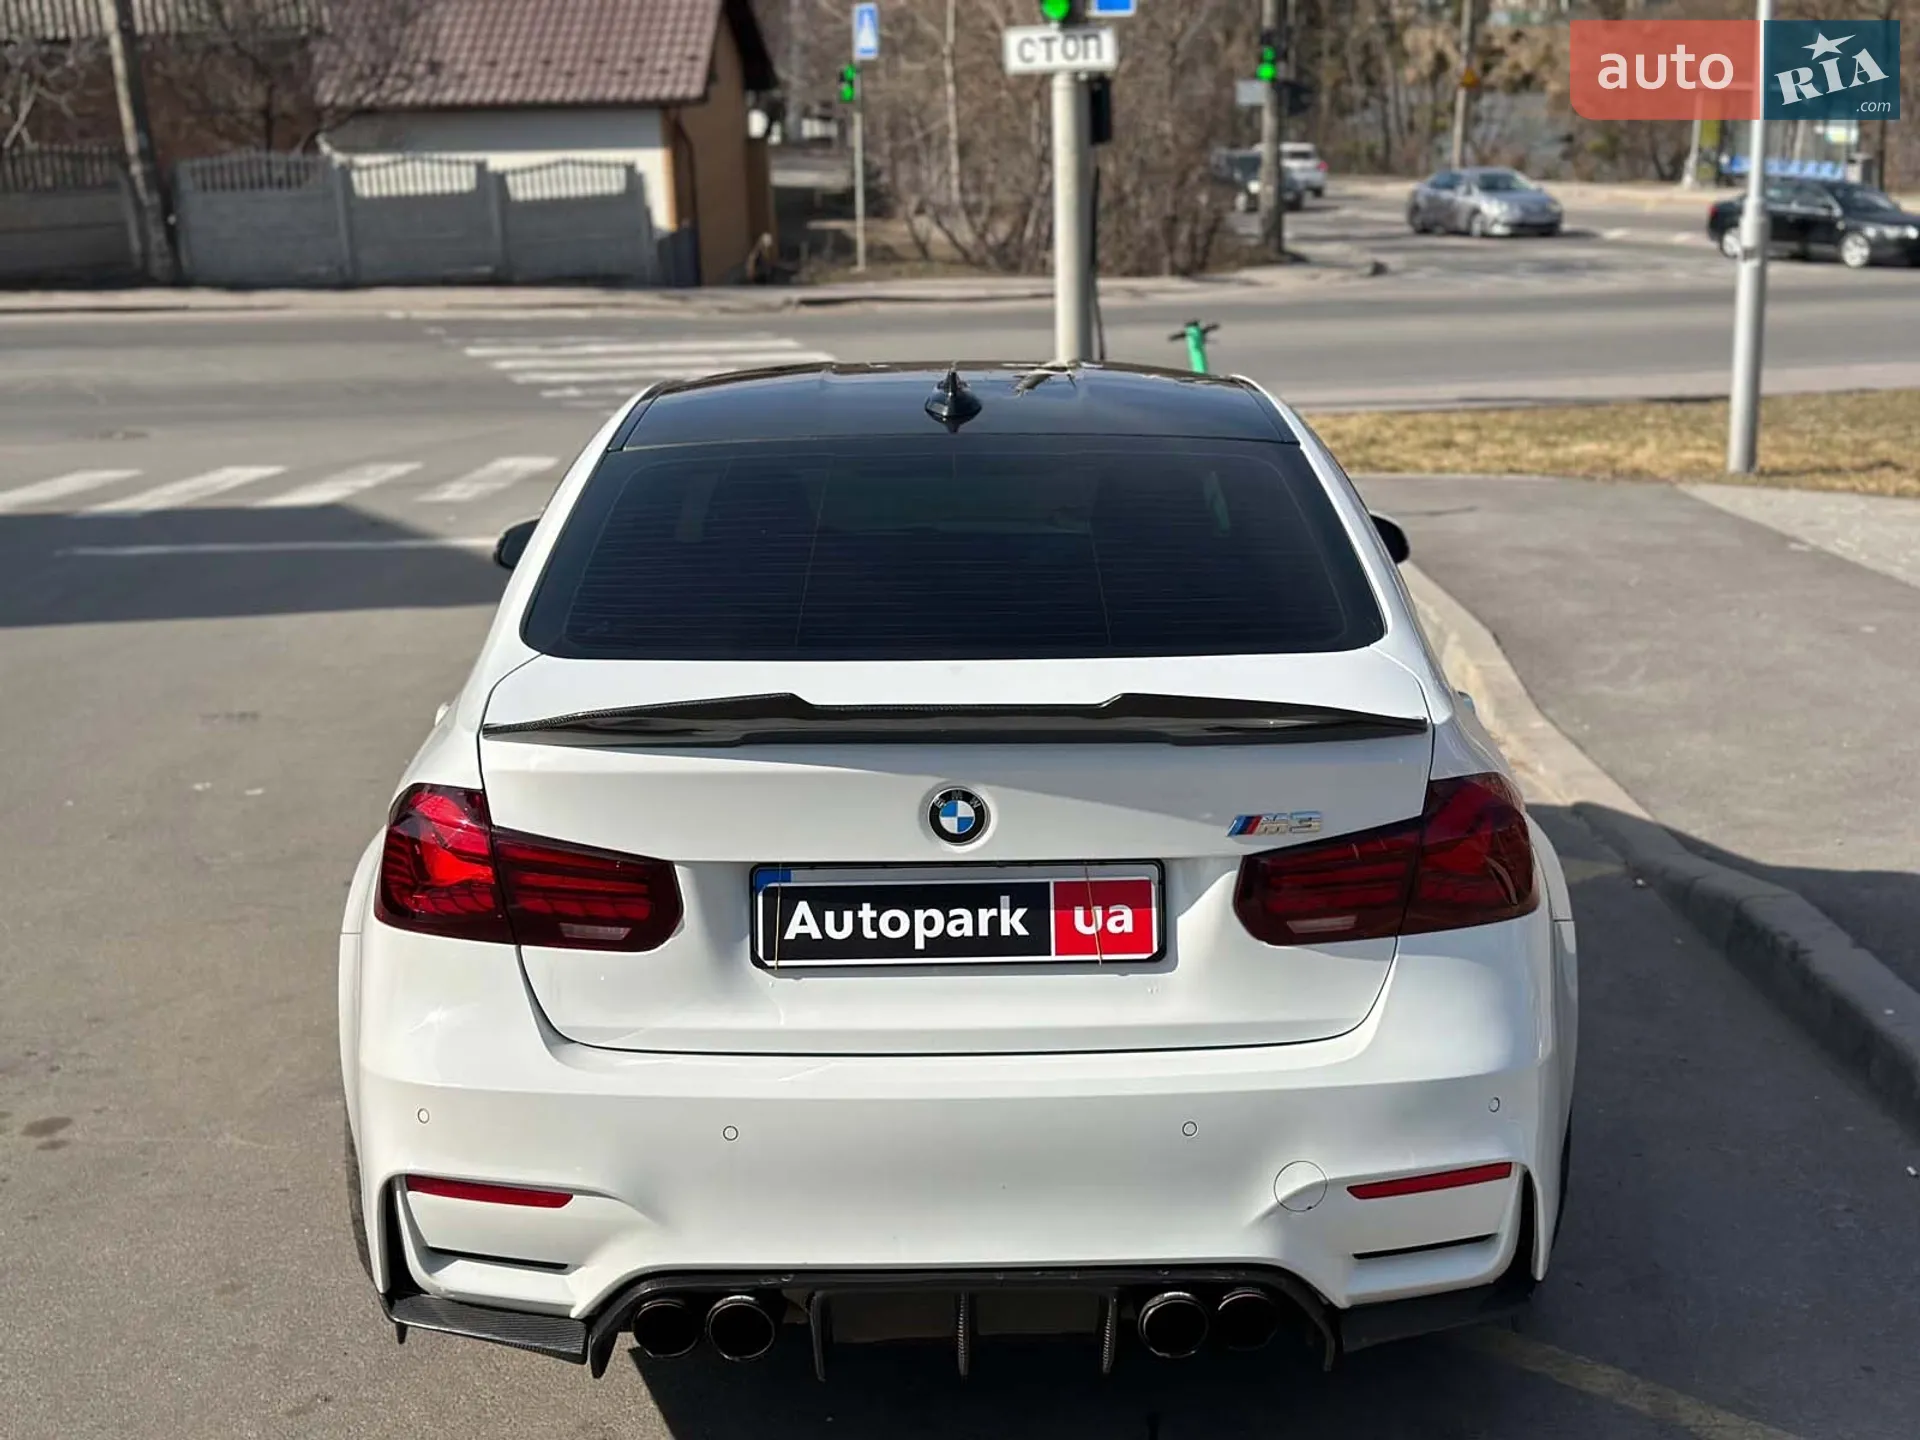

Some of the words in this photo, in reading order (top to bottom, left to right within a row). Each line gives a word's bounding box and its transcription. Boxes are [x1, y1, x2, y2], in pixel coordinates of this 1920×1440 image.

[1017, 33, 1103, 63] СТОП
[934, 790, 981, 808] BMW
[1254, 811, 1321, 834] M3
[784, 895, 1029, 949] Autopark
[1074, 904, 1133, 935] ua
